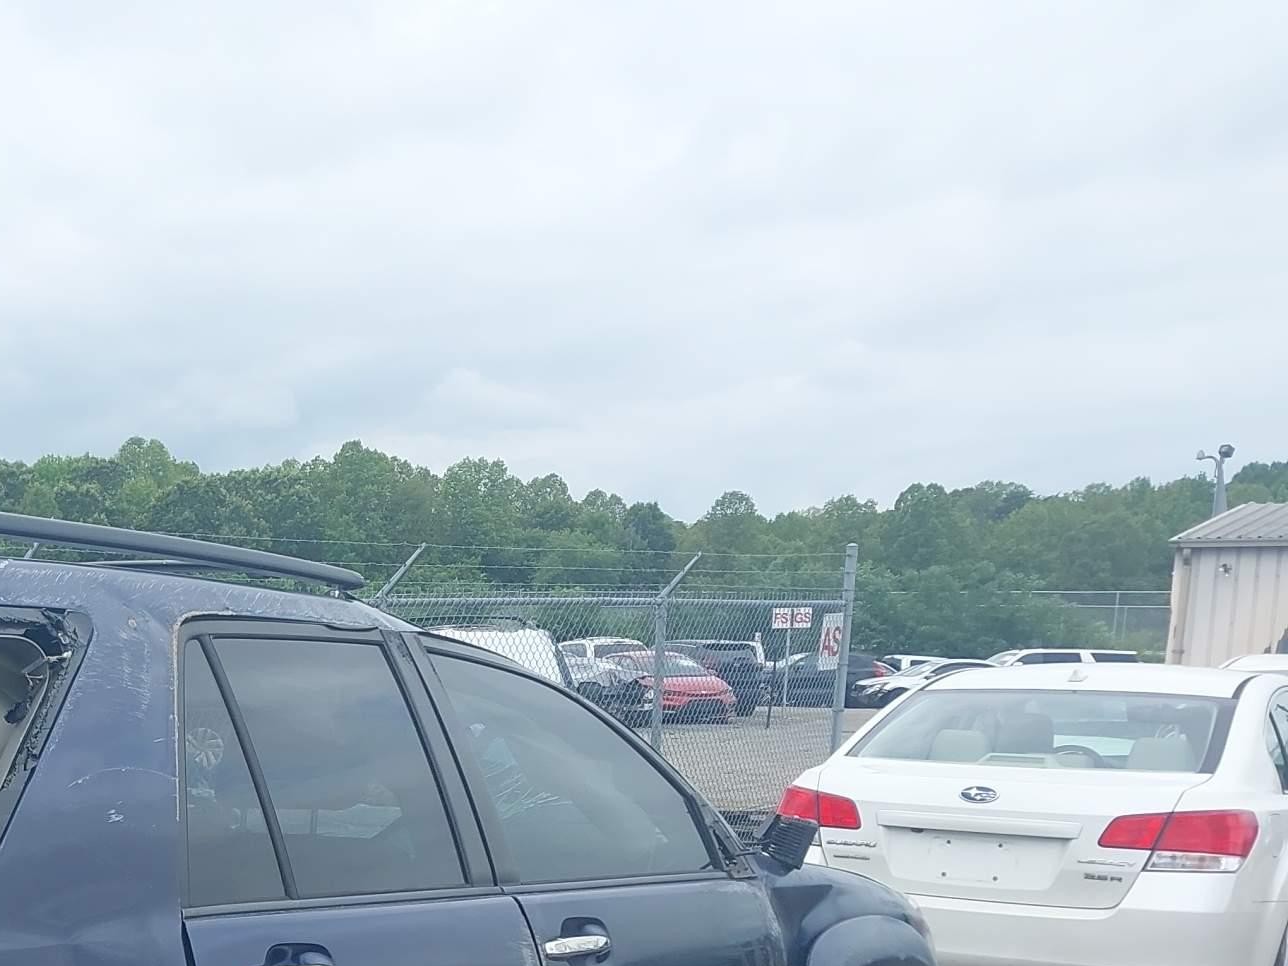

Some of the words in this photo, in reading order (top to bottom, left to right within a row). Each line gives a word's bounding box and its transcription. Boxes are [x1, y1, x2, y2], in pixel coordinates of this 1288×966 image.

[774, 612, 789, 624] FS
[794, 612, 811, 624] GS
[820, 626, 841, 657] AS
